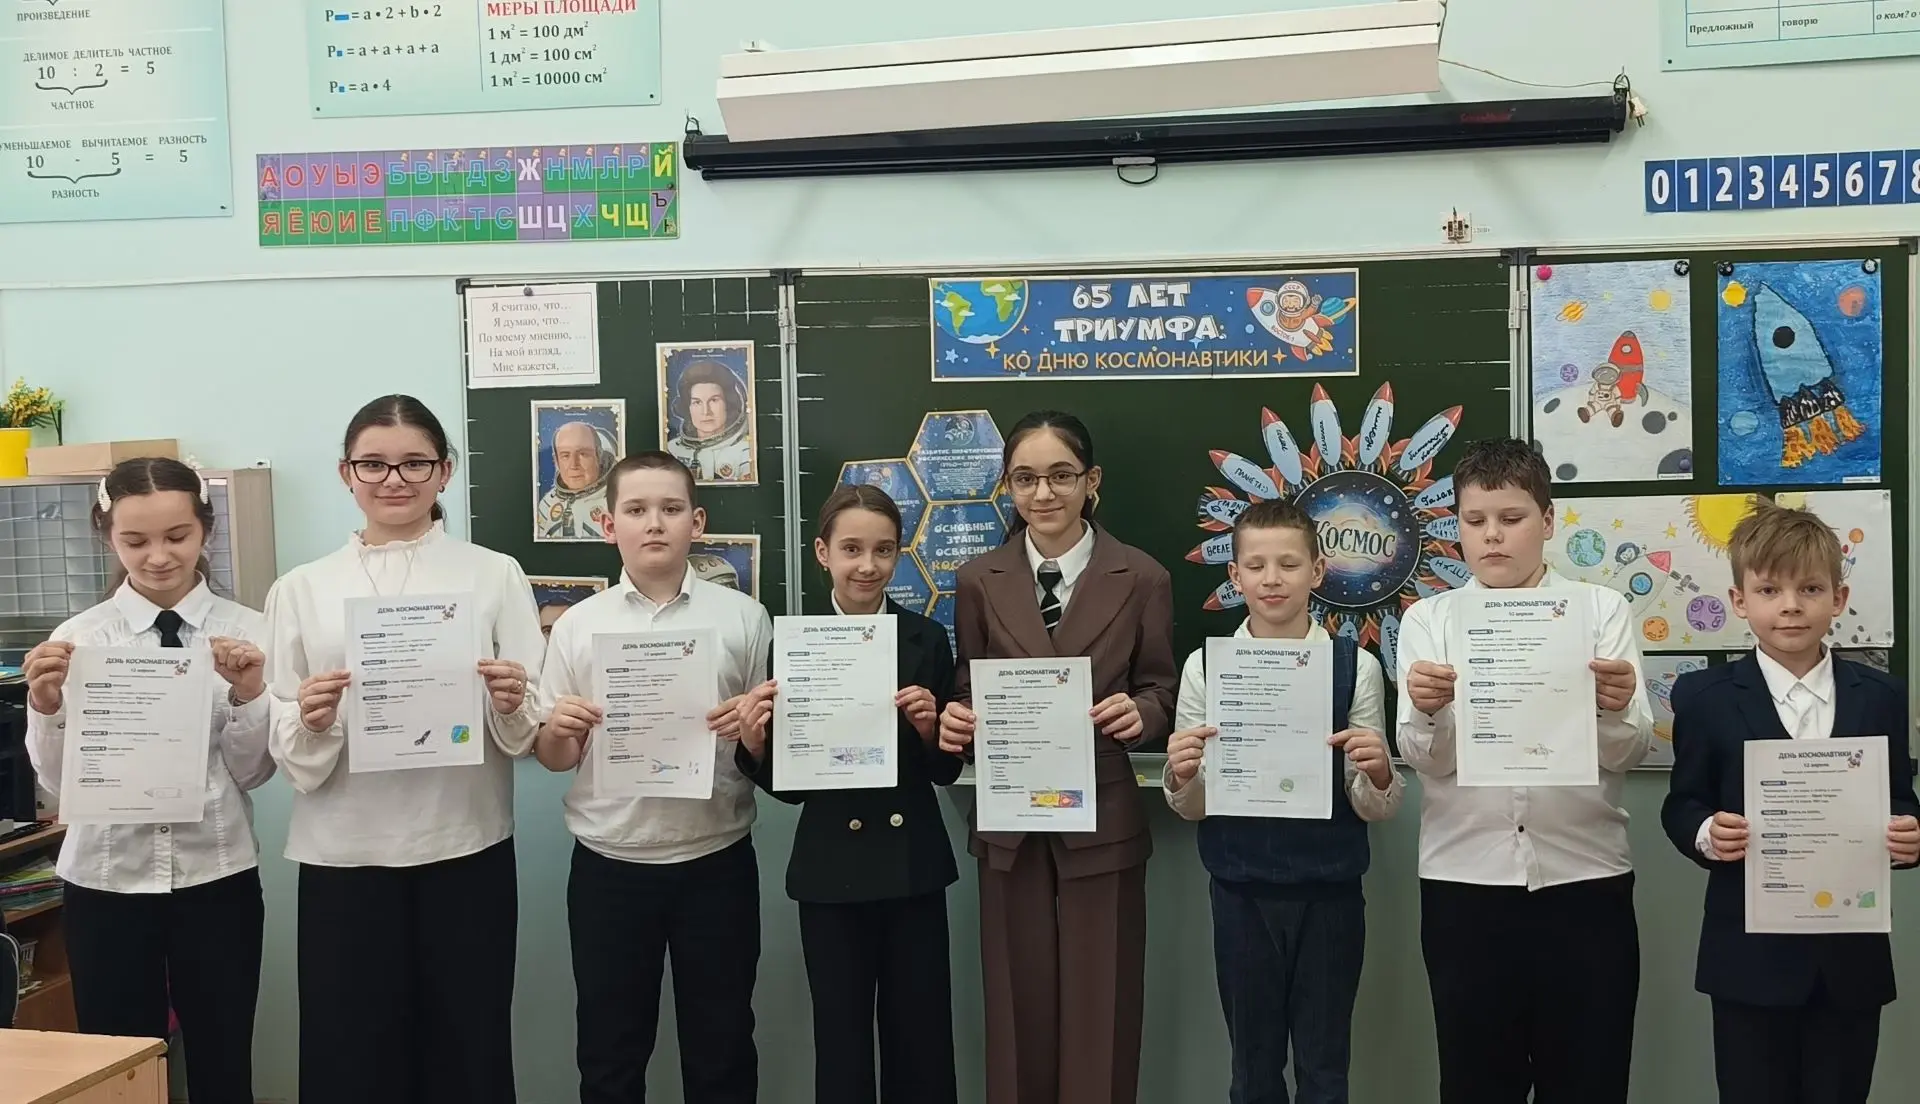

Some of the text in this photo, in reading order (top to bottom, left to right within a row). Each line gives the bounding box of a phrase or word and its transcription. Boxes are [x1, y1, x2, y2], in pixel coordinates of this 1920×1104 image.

[385, 7, 393, 19] 2
[433, 4, 441, 17] 2
[487, 0, 636, 16] МЕРЫ ПЛОЩАДИ
[17, 10, 91, 22] ПРОИЗВЕДЕНИЕ
[1782, 17, 1818, 28] говорю
[488, 28, 495, 40] 1
[533, 25, 560, 38] 100
[1689, 21, 1754, 34] Предложный
[23, 46, 172, 62] ДЕЛИМОЕ ДЕЛИТЕЛЬ ЧАСТНОЕ
[489, 51, 496, 63] 1
[544, 48, 570, 61] 100
[38, 61, 155, 79] 10 2 5
[383, 79, 391, 91] 4
[491, 75, 498, 87] 1
[536, 71, 580, 85] 10000
[51, 100, 94, 110] ЧАСТНОЕ
[81, 137, 148, 148] ВЫЧИТАЕМОЕ
[159, 135, 207, 145] РАЗНОСТЬ
[27, 150, 188, 168] 10 5 5
[52, 189, 99, 199] РАЗНОСТЬ
[1072, 281, 1192, 309] 65 ЛЕТ
[491, 302, 499, 312] Я
[501, 304, 541, 312] считаю,
[493, 318, 501, 327] Я
[503, 318, 540, 329] думаю,
[479, 333, 572, 344] По моему мнению,
[489, 348, 503, 357] На
[505, 347, 525, 357] мой
[493, 362, 559, 372] Мне кажется,
[1003, 349, 1268, 373] КО ДНЮ КОСМОНАВТИКИ
[934, 521, 996, 533] ОСНОВНЫЕ
[946, 534, 985, 545] ЭТАПЫ
[1206, 543, 1231, 557] ВСЕЛЕ
